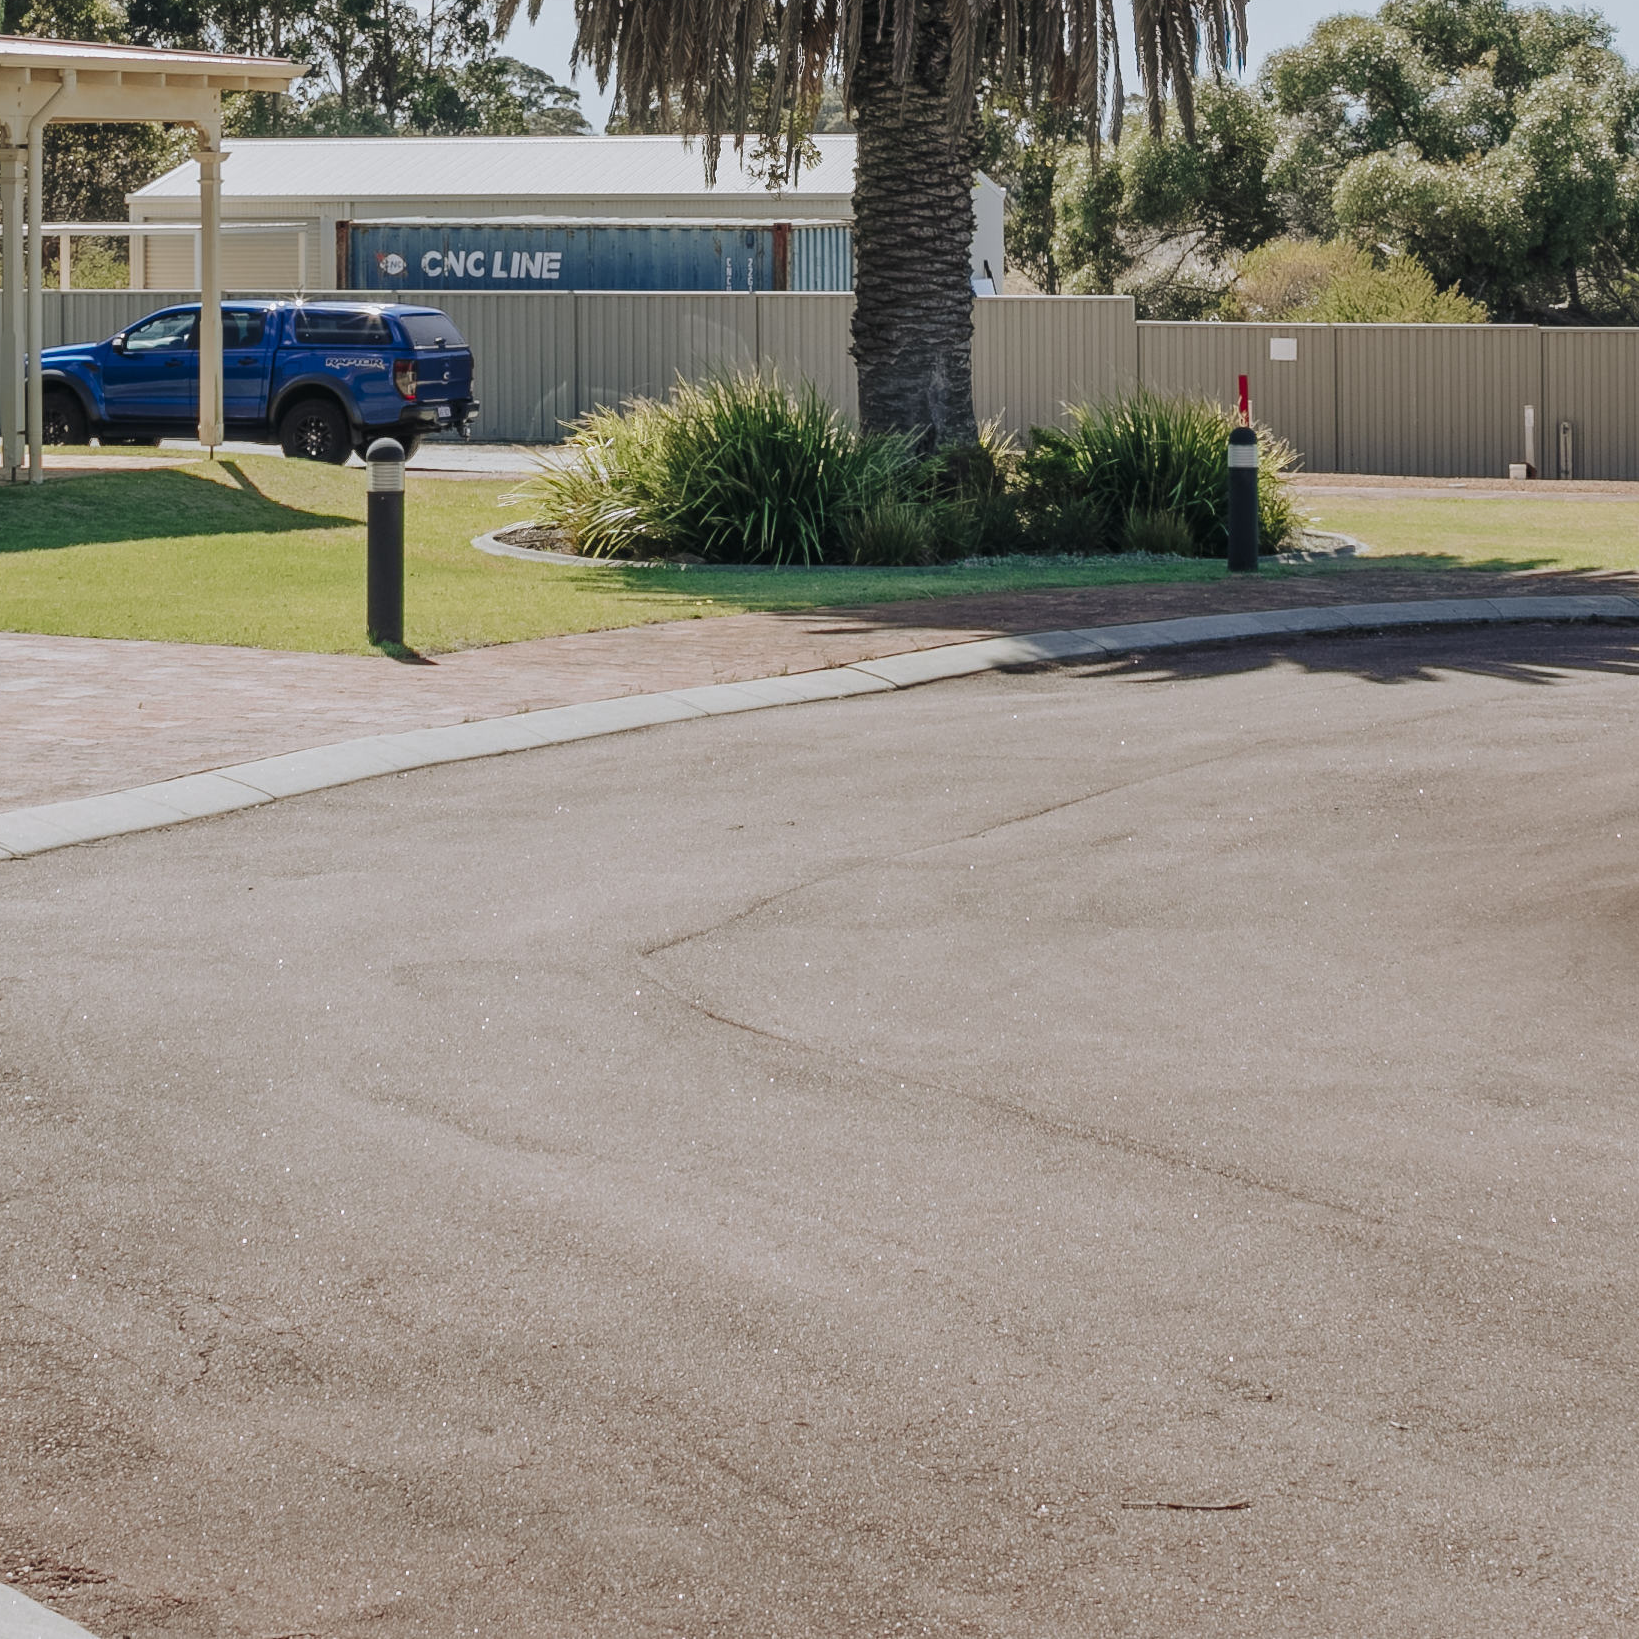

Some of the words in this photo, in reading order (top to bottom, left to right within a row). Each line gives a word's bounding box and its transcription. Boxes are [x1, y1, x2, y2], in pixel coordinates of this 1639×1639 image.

[421, 250, 485, 277] CNC
[492, 251, 562, 279] LINE
[325, 357, 386, 370] RAPTOR
